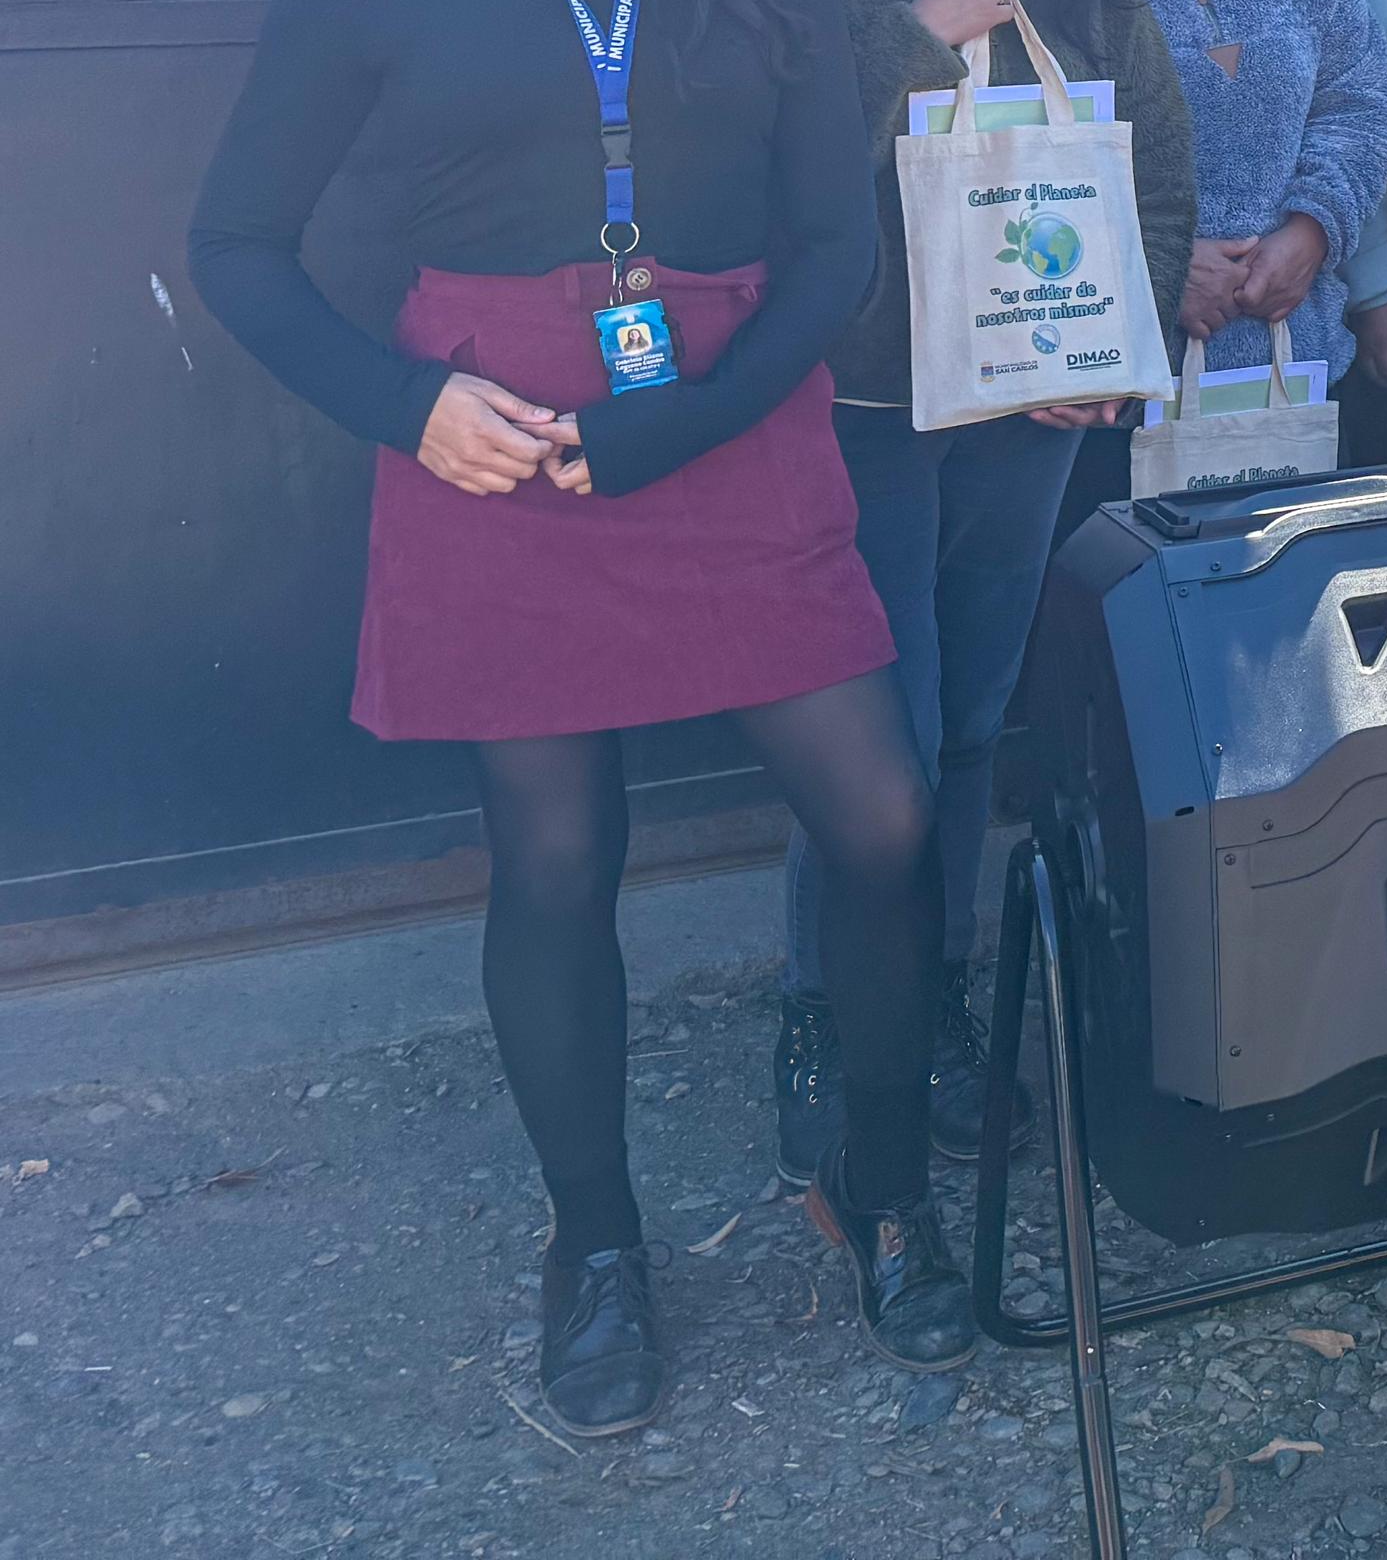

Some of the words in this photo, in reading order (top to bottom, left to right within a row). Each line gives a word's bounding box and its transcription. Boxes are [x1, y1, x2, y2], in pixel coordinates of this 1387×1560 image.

[968, 187, 1022, 207] Cuidar
[1025, 184, 1037, 201] el
[1039, 184, 1097, 201] Planeta
[1023, 284, 1072, 302] cuidar
[1076, 281, 1097, 297] de
[976, 307, 1046, 328] nosotros
[1066, 349, 1121, 366] DIMAO
[1187, 473, 1230, 491] Cuidar
[1233, 469, 1245, 483] el
[1248, 465, 1299, 481] Planeta
